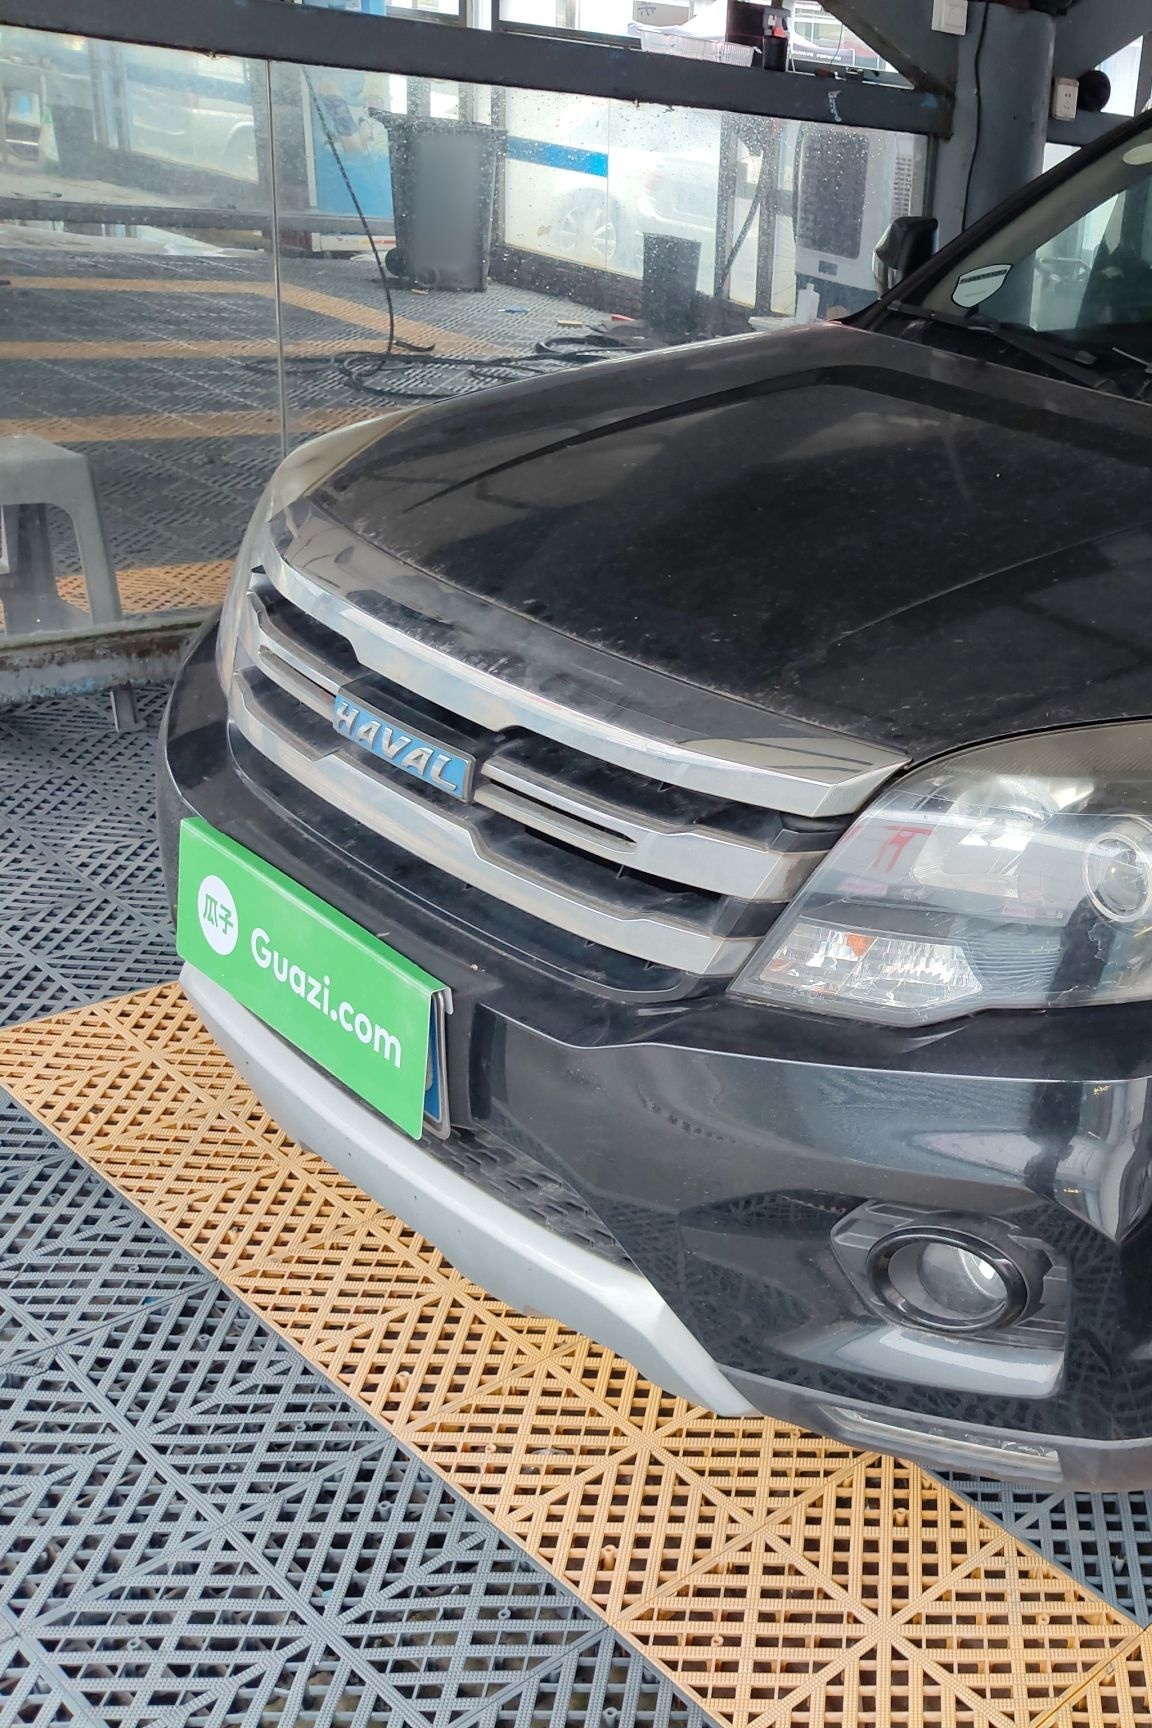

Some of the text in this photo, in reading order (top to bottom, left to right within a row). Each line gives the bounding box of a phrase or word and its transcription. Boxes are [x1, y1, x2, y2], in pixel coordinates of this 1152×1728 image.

[336, 701, 457, 791] HAVAL
[202, 893, 235, 935] 瓜子
[251, 927, 402, 1069] Guazi.com
